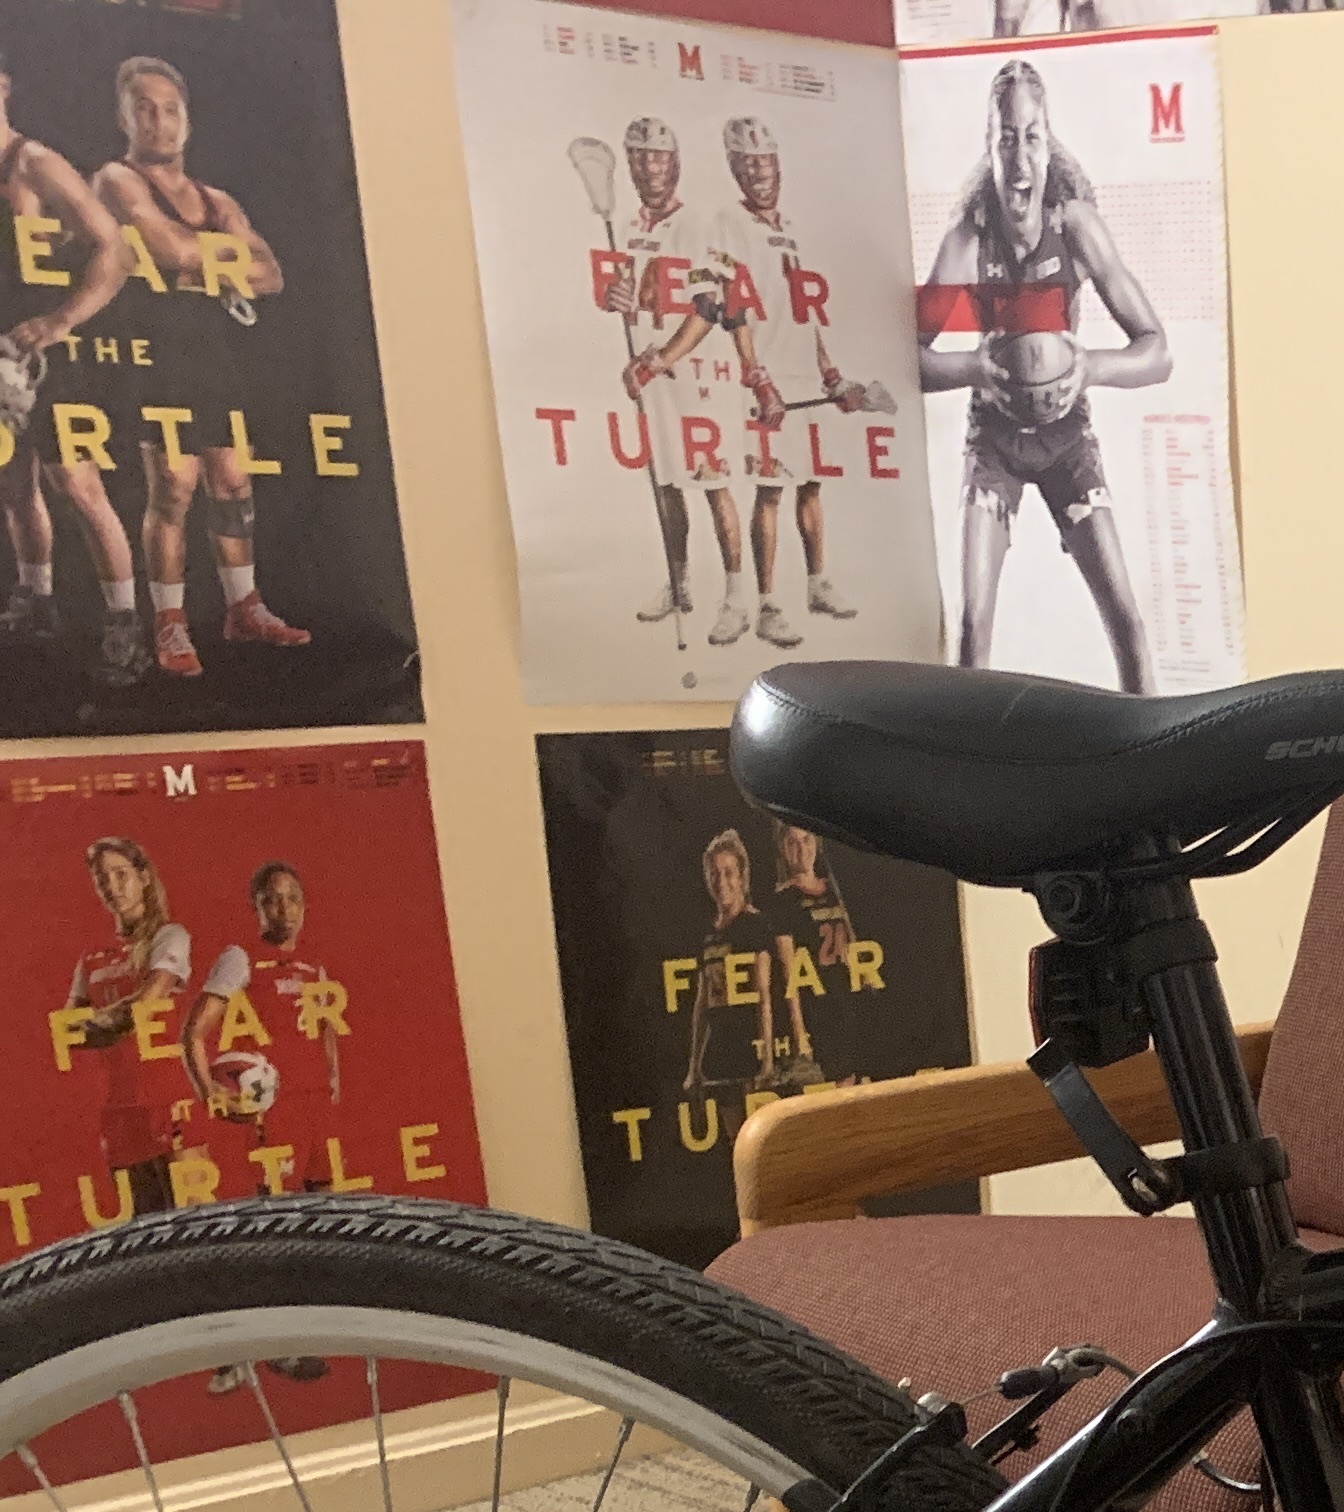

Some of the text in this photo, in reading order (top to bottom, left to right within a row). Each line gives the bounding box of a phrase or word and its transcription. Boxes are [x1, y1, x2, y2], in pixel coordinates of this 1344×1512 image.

[677, 42, 704, 75] M
[1149, 83, 1184, 135] M
[589, 247, 831, 327] FEAR
[60, 332, 154, 367] THE
[535, 407, 900, 479] TURTLE
[163, 763, 198, 797] M
[661, 940, 886, 1013] FEAR
[49, 980, 351, 1072] FEAR
[0, 1122, 447, 1246] TURTLE
